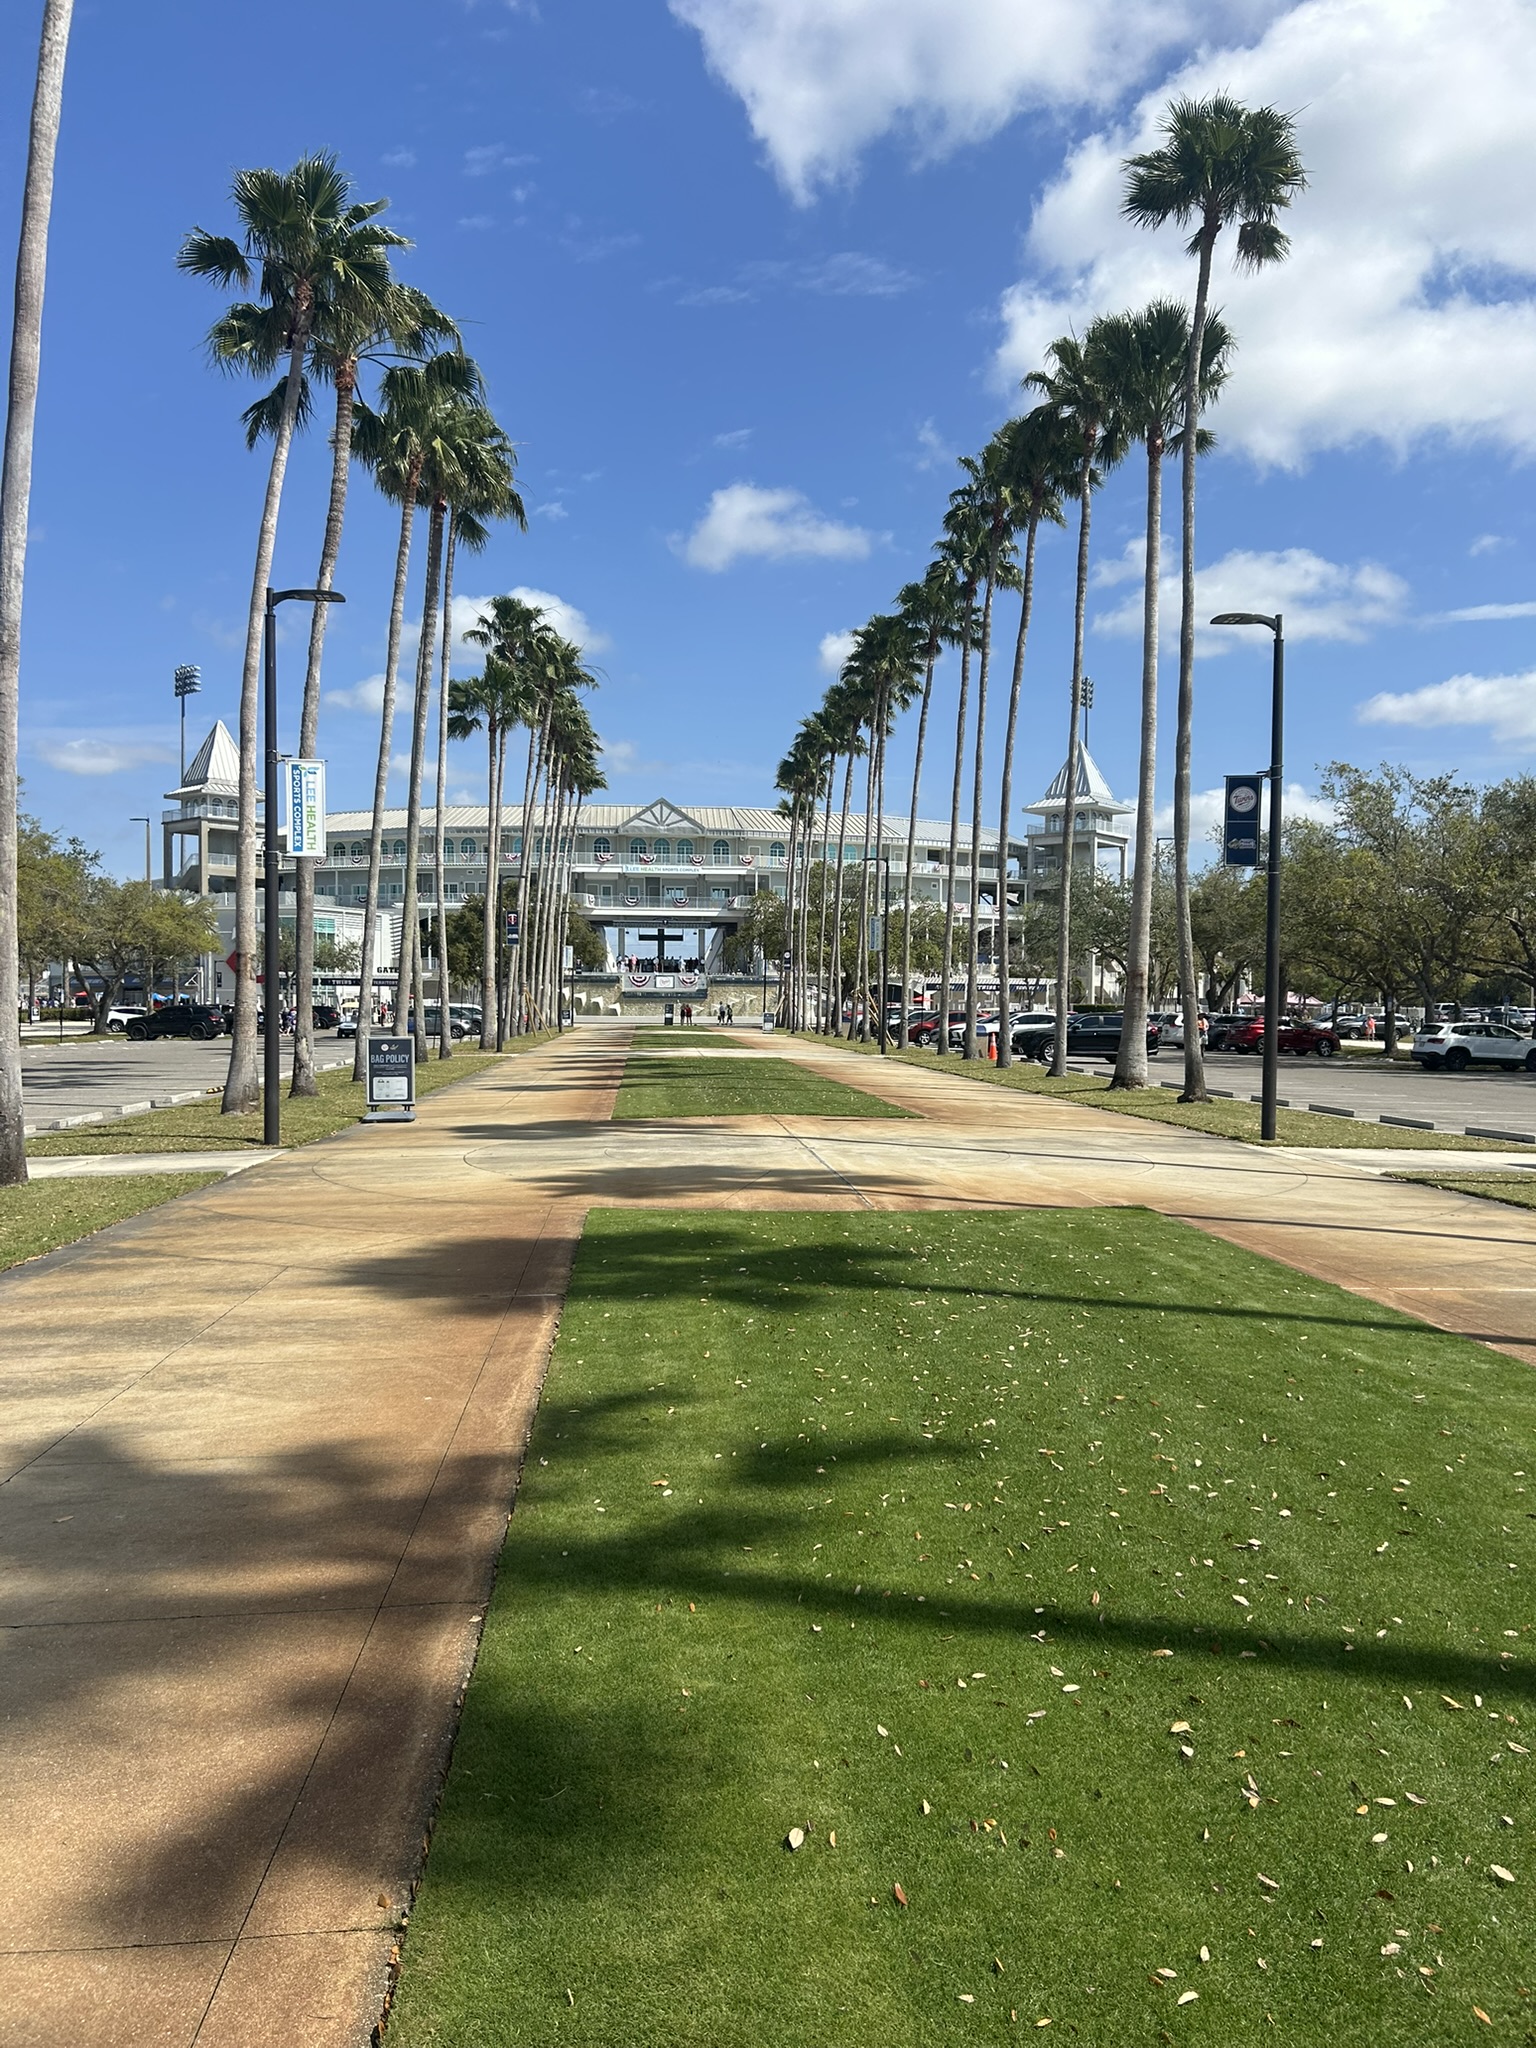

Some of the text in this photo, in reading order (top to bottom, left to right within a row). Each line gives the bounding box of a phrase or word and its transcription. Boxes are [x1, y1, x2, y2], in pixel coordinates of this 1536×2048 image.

[292, 769, 302, 847] SPORTS COMPLEX
[305, 780, 317, 850] LEE HEALTH
[370, 1054, 410, 1064] BAG POLICY
